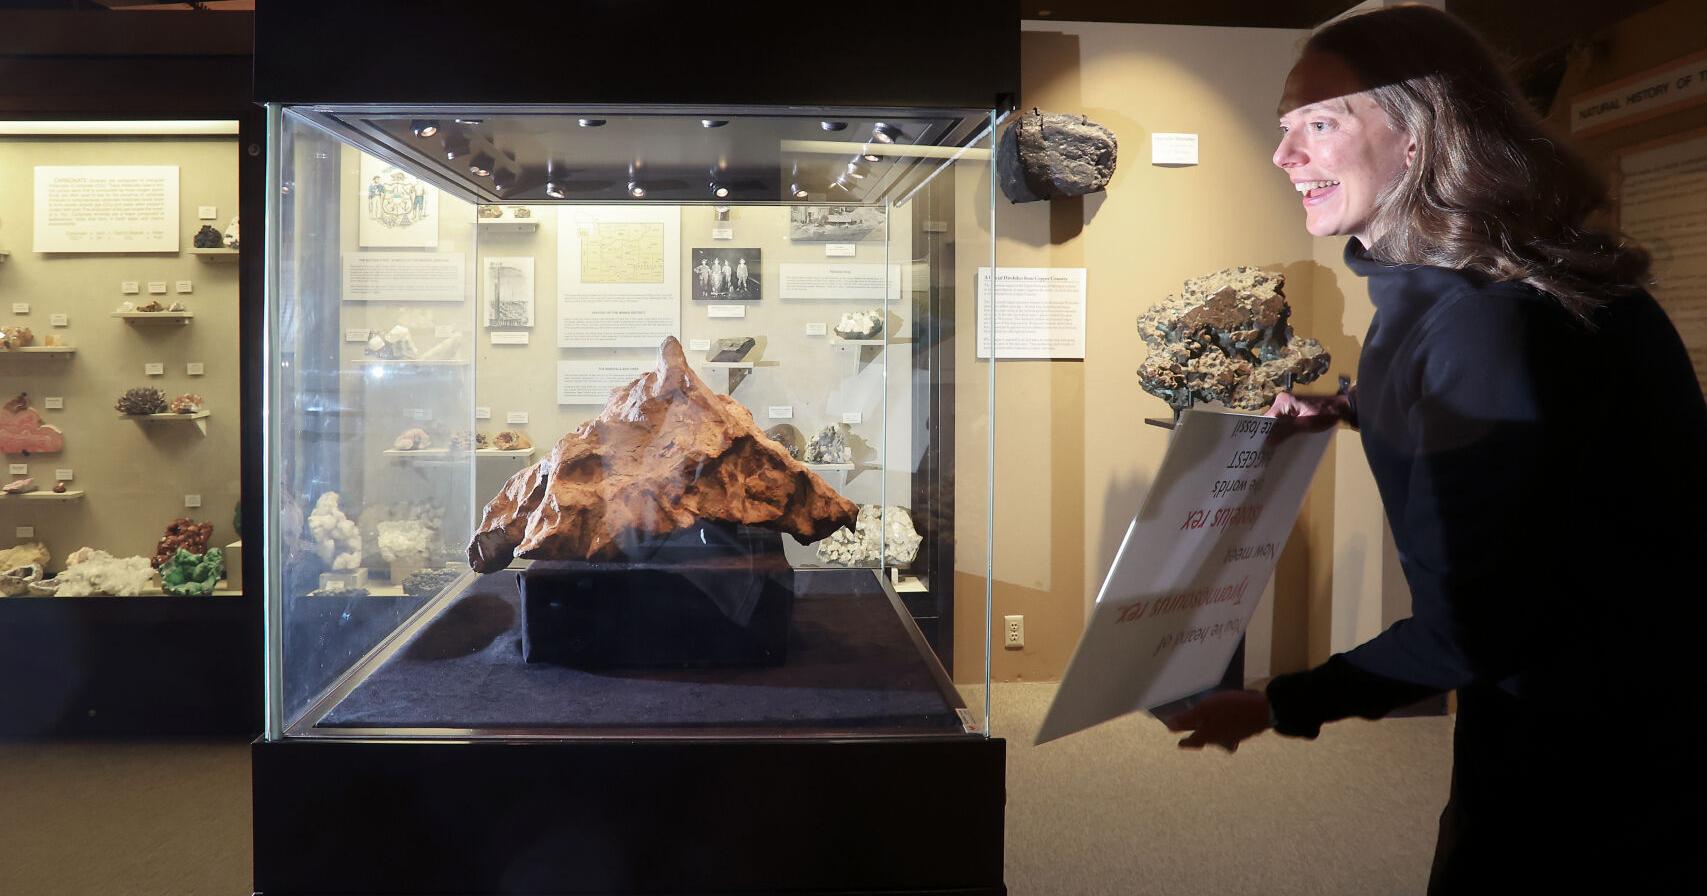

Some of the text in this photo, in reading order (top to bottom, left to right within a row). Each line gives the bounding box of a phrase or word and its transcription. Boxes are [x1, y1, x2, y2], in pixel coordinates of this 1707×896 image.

[1579, 98, 1621, 120] NATURAL
[1626, 83, 1669, 106] HISTORY
[1676, 75, 1692, 90] OF
[1232, 420, 1260, 439] fossil
[1213, 480, 1247, 498] world's
[1181, 510, 1211, 531] rex
[1222, 542, 1280, 565] Now meet
[1115, 602, 1149, 624] rex
[1170, 626, 1209, 650] heard
